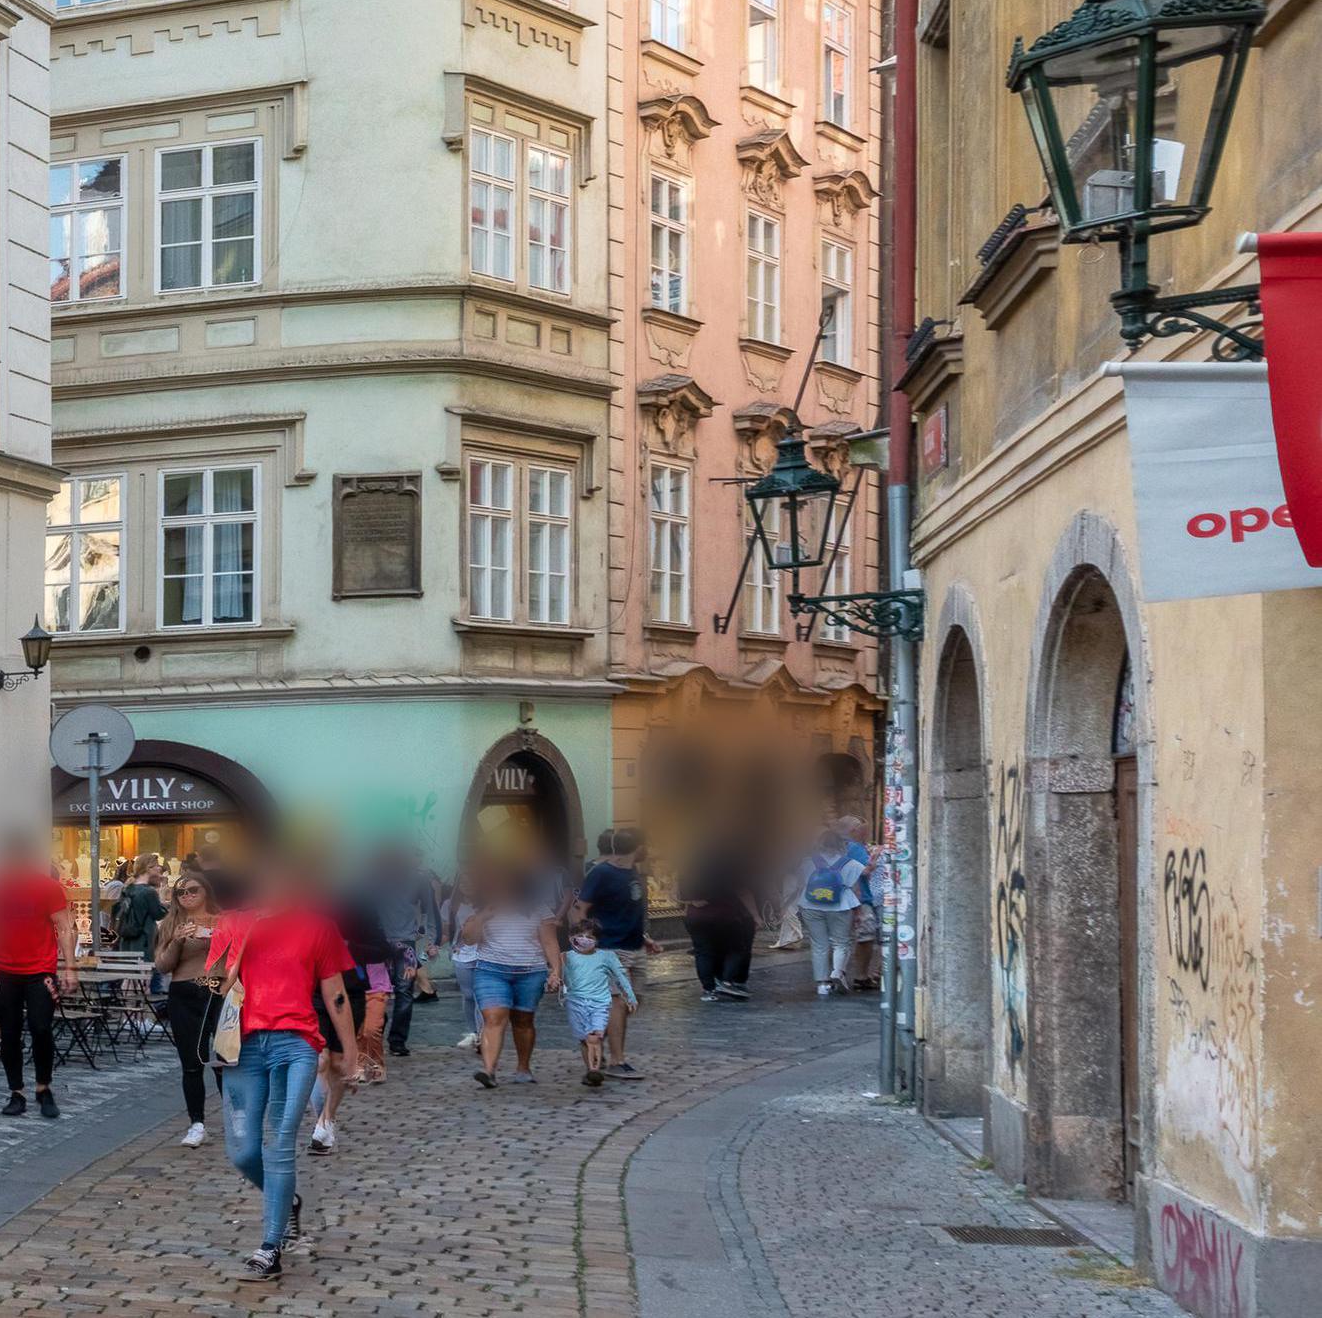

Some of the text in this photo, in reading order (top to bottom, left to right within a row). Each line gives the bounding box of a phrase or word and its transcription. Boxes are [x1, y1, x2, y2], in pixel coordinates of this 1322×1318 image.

[107, 777, 177, 800] VILY
[494, 768, 528, 791] VILY
[69, 800, 215, 813] EXCUSIVE GARNET SHOP
